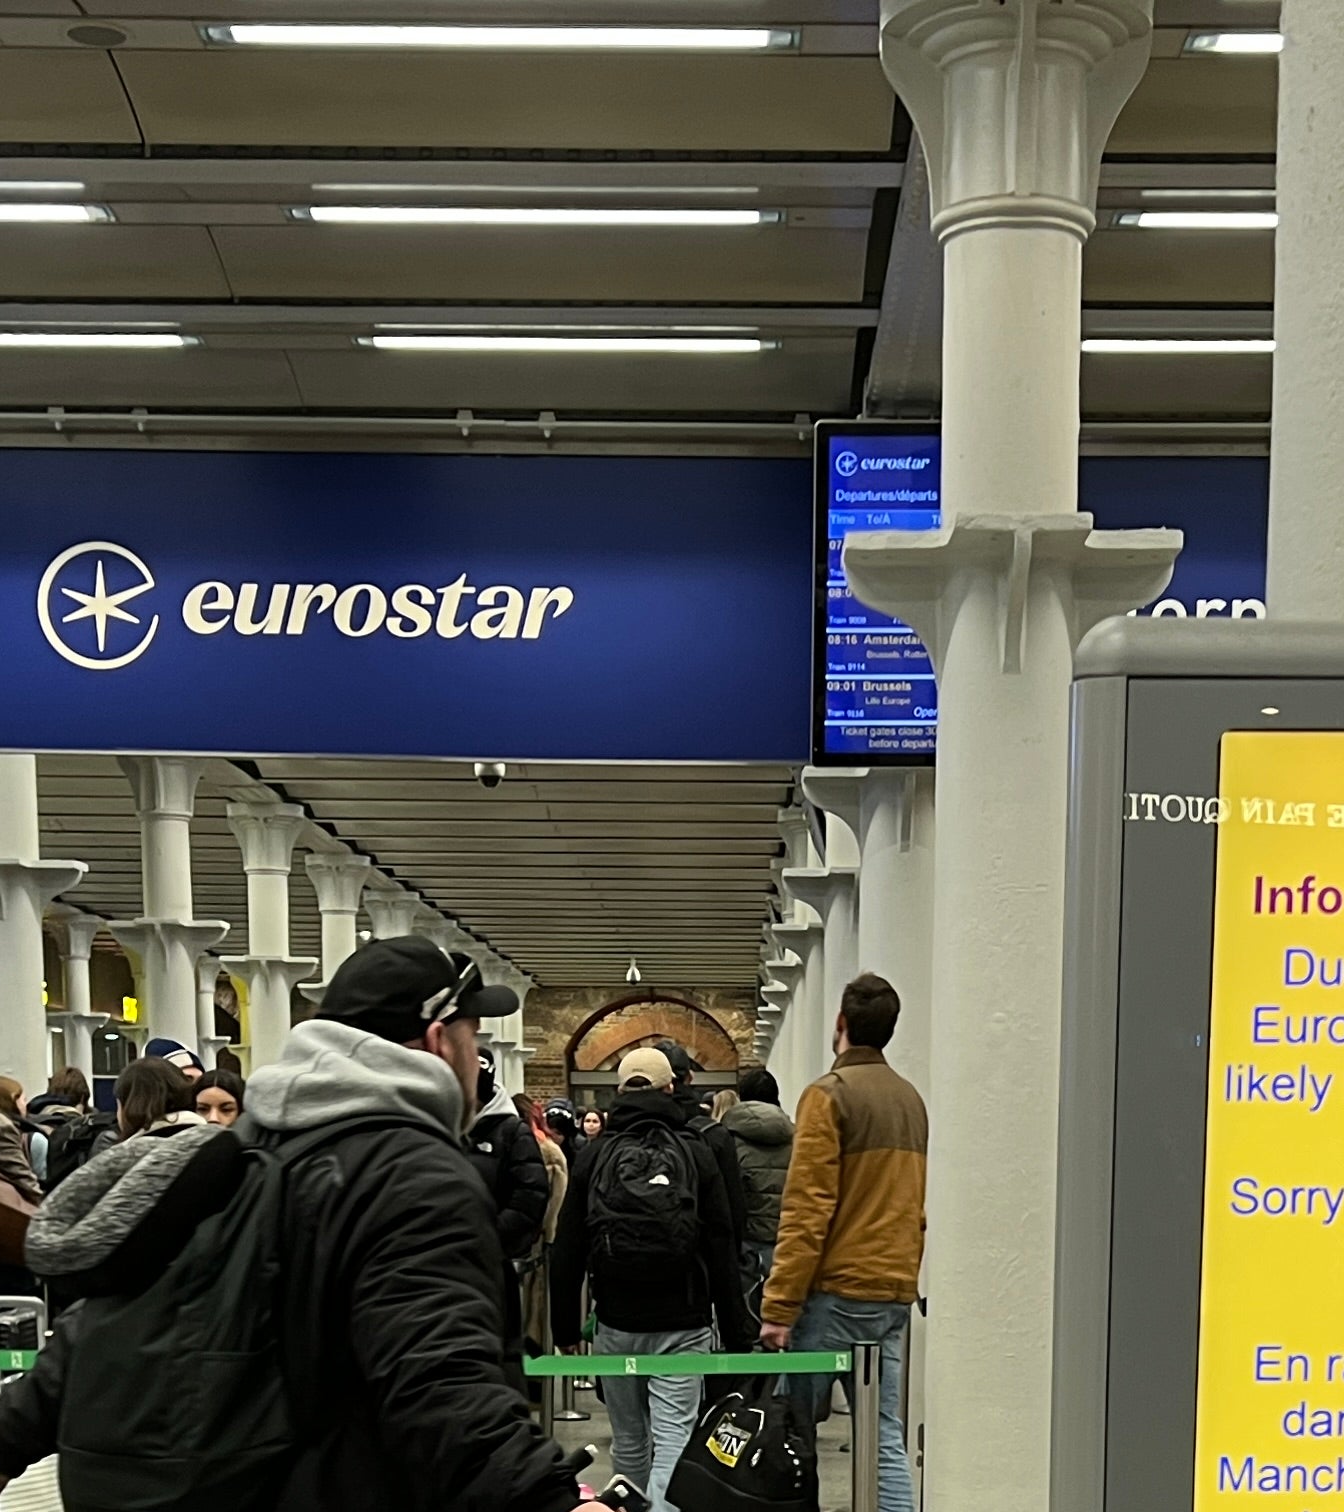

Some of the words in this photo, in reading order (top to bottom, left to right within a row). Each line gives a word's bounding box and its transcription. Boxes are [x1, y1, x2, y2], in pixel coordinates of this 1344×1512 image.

[861, 457, 931, 470] eurostar
[830, 514, 855, 525] Time
[181, 572, 574, 640] eurostar
[862, 681, 912, 691] Brussels
[1253, 874, 1344, 915] Info
[1225, 1063, 1333, 1113] likely
[1254, 1345, 1310, 1383] En
